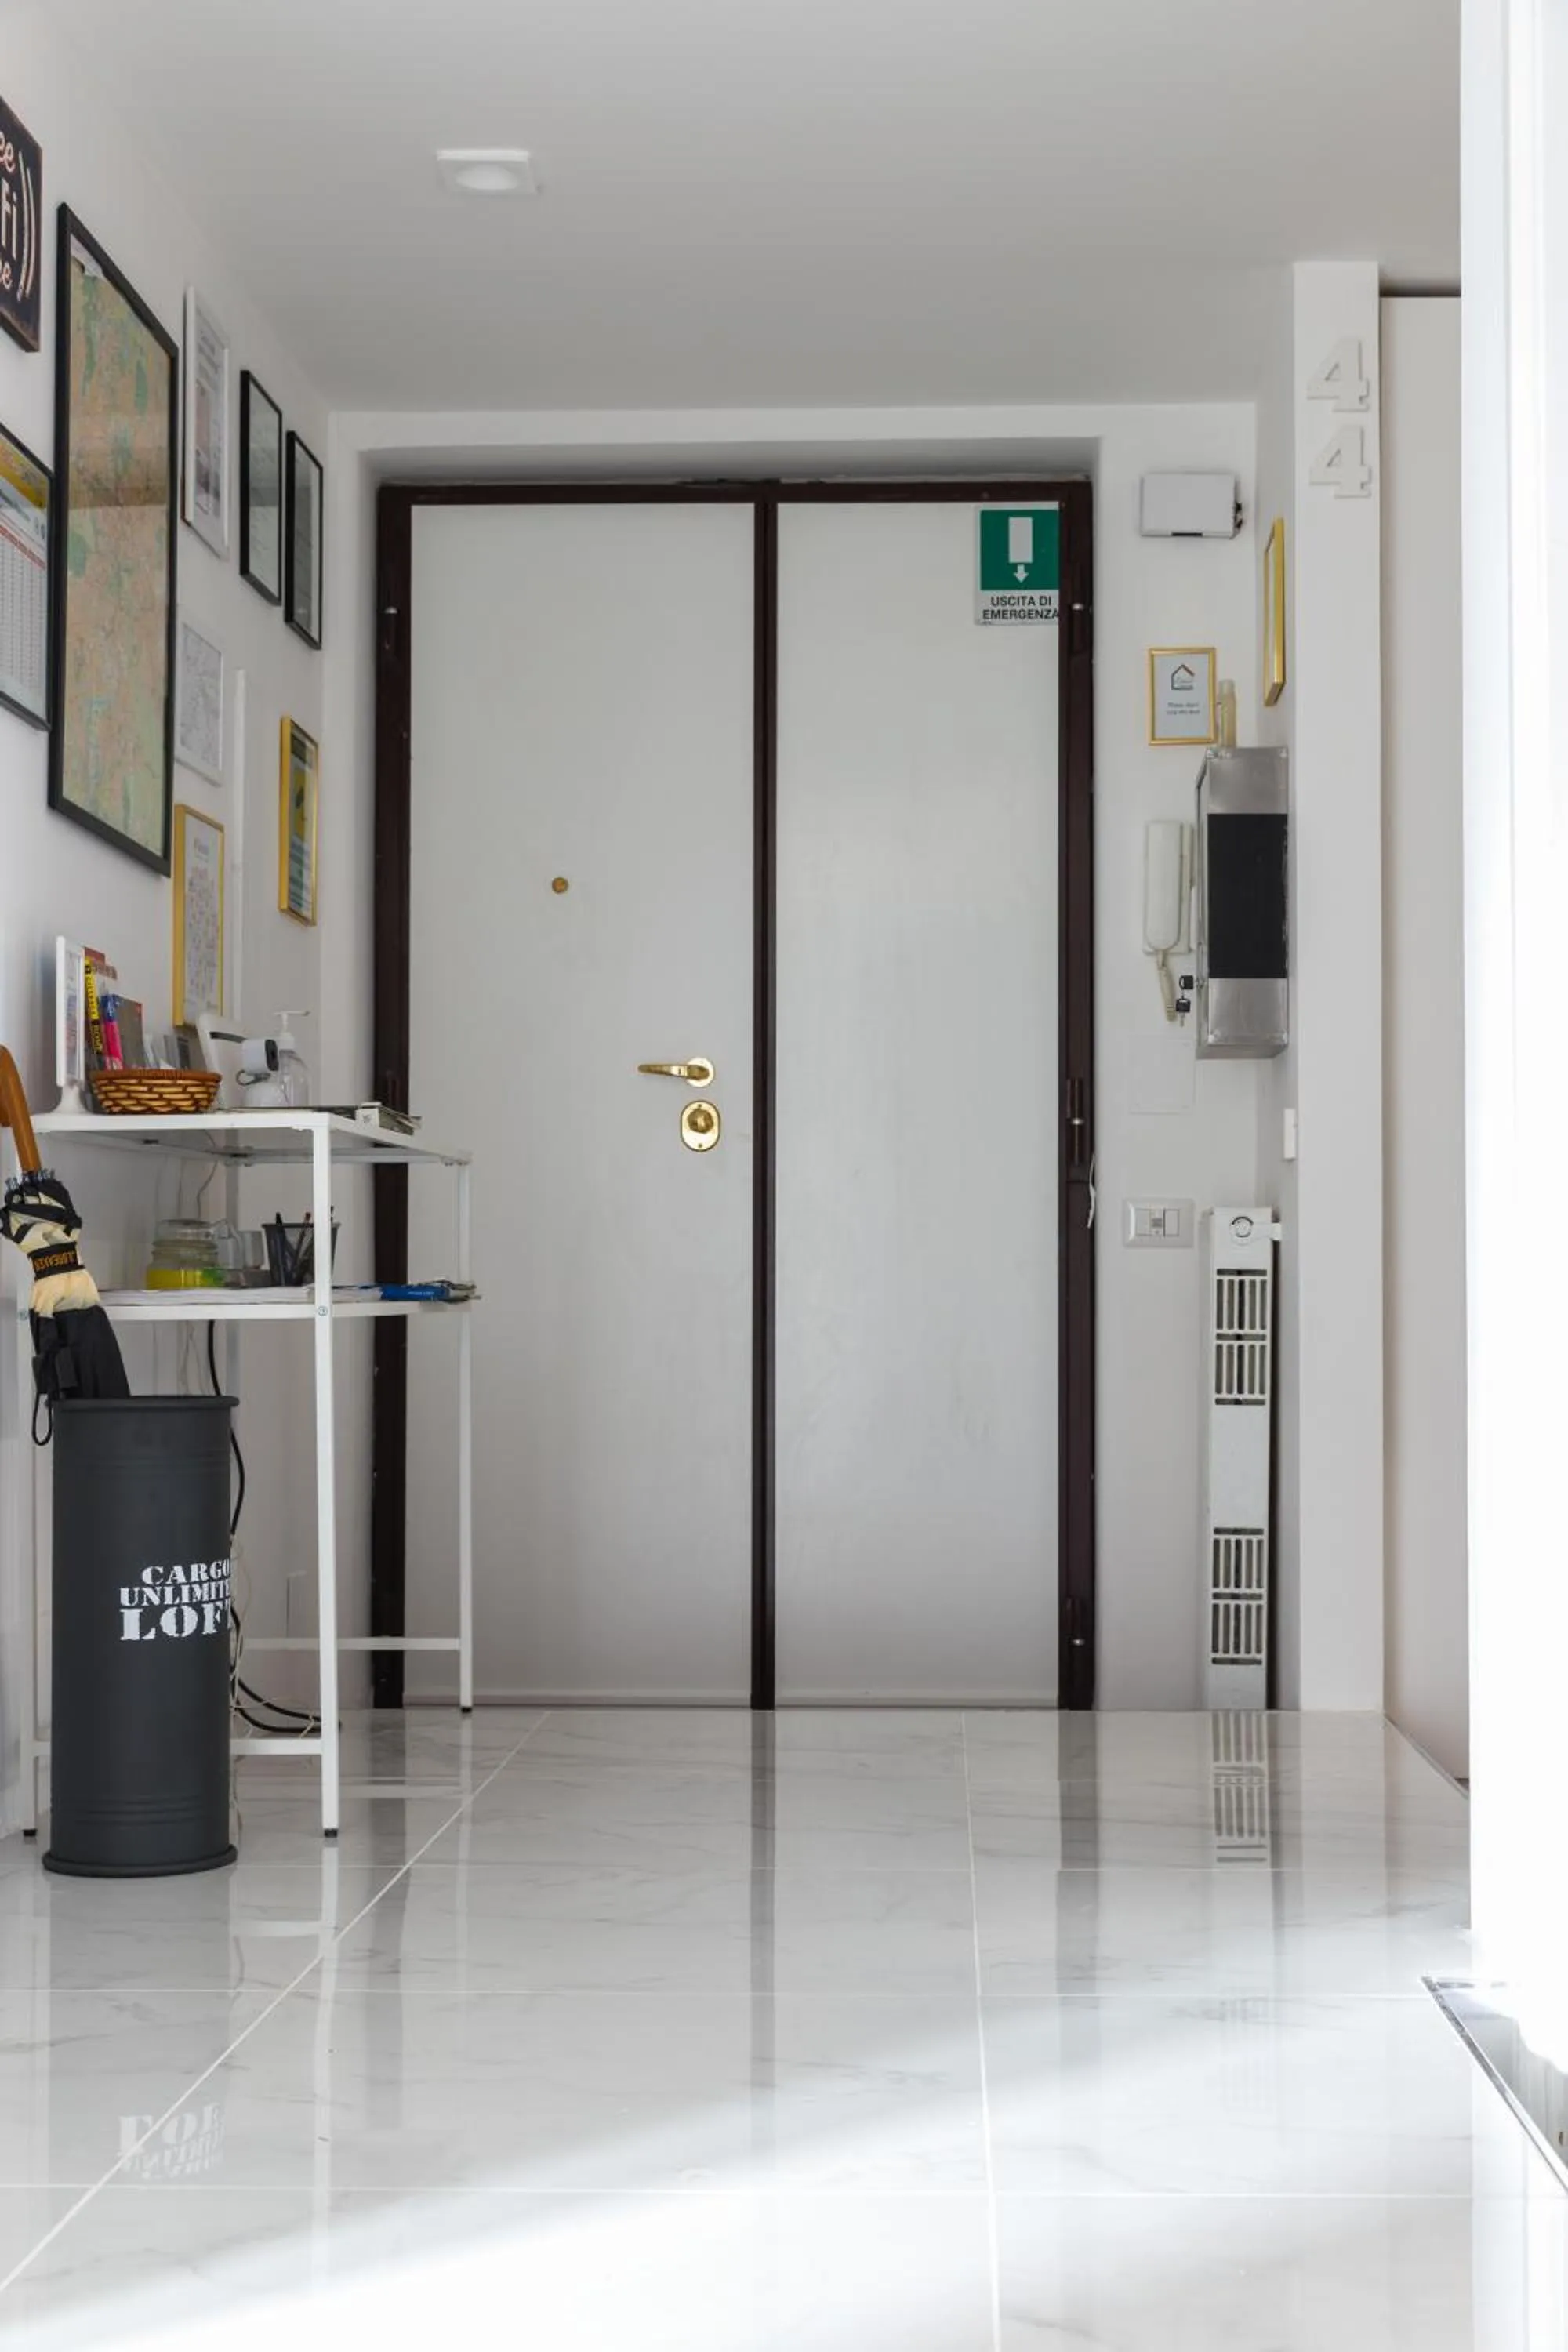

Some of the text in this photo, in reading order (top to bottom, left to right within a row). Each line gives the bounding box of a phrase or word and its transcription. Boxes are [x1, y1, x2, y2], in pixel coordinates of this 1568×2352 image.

[990, 596, 1052, 607] USCITA DI
[982, 608, 1059, 619] EMERGENZA
[141, 1558, 230, 1585] CARGO
